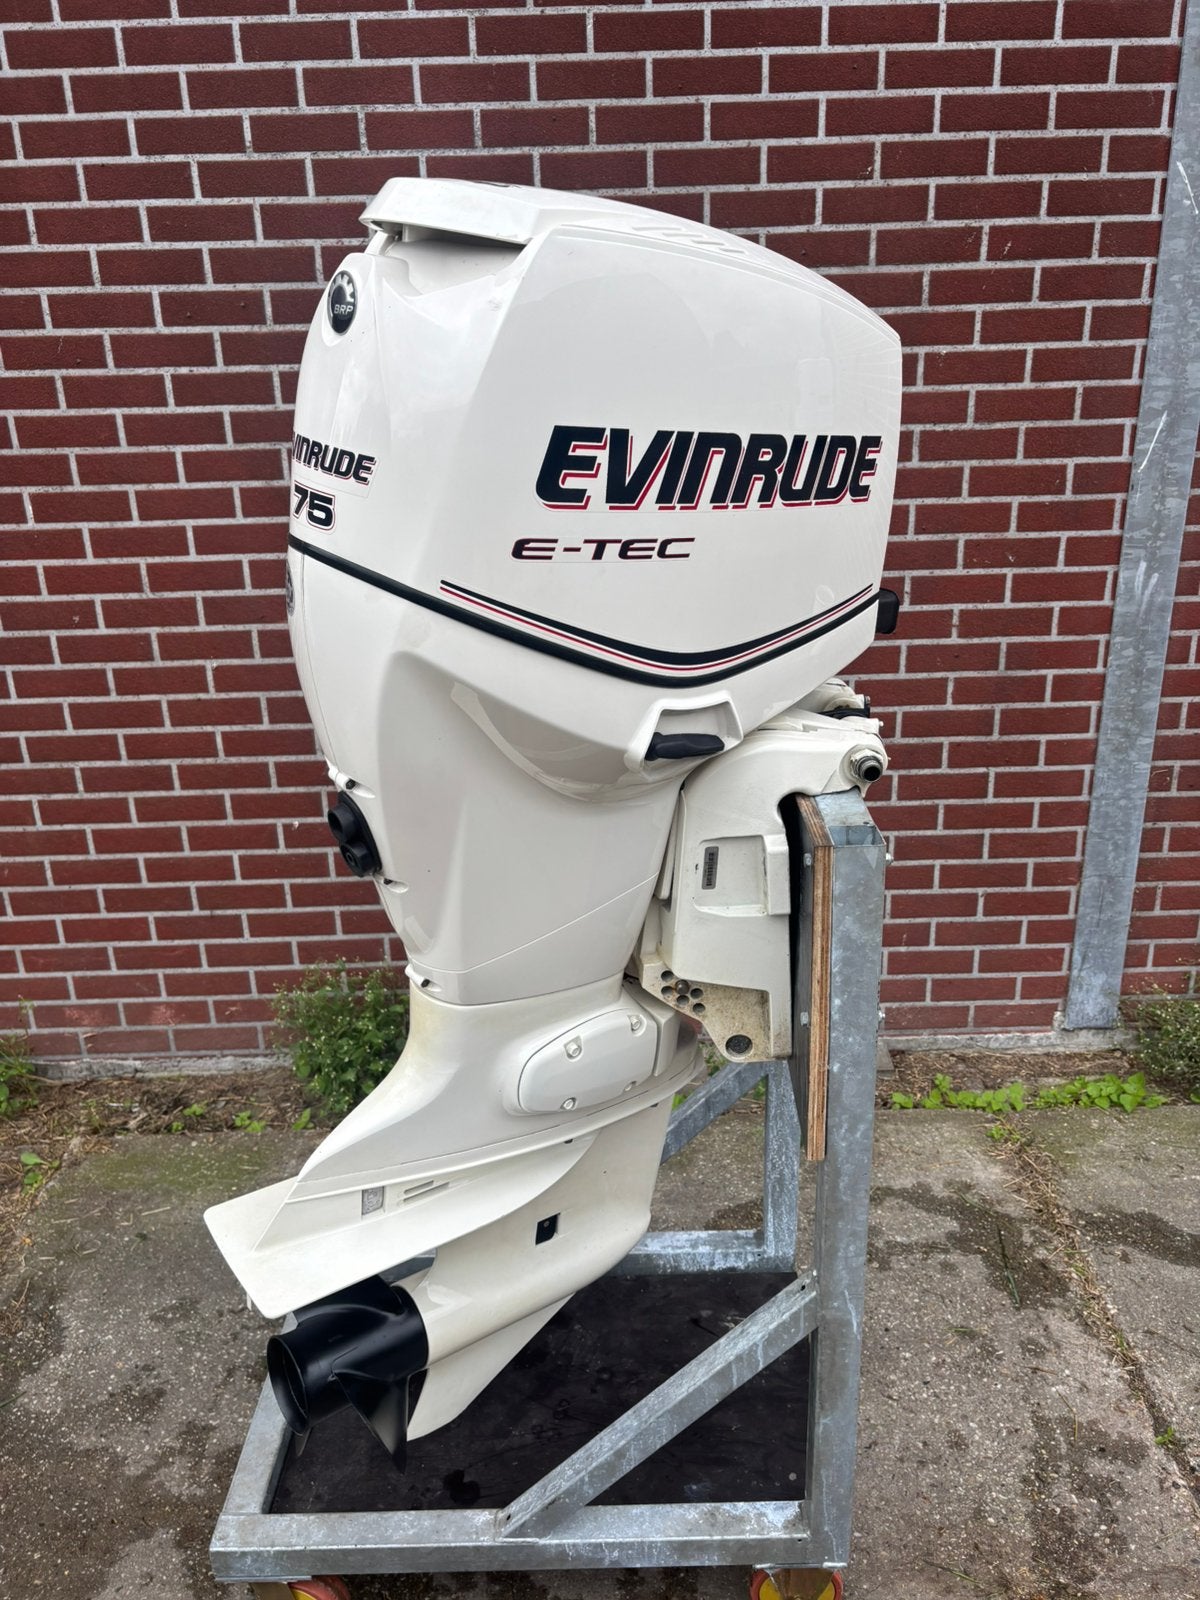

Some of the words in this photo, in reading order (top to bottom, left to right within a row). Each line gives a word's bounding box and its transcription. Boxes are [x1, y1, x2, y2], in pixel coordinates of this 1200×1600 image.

[333, 304, 354, 315] BRP
[535, 425, 882, 511] EVINRUDE
[294, 482, 334, 529] 75
[511, 537, 695, 561] E-TEC
